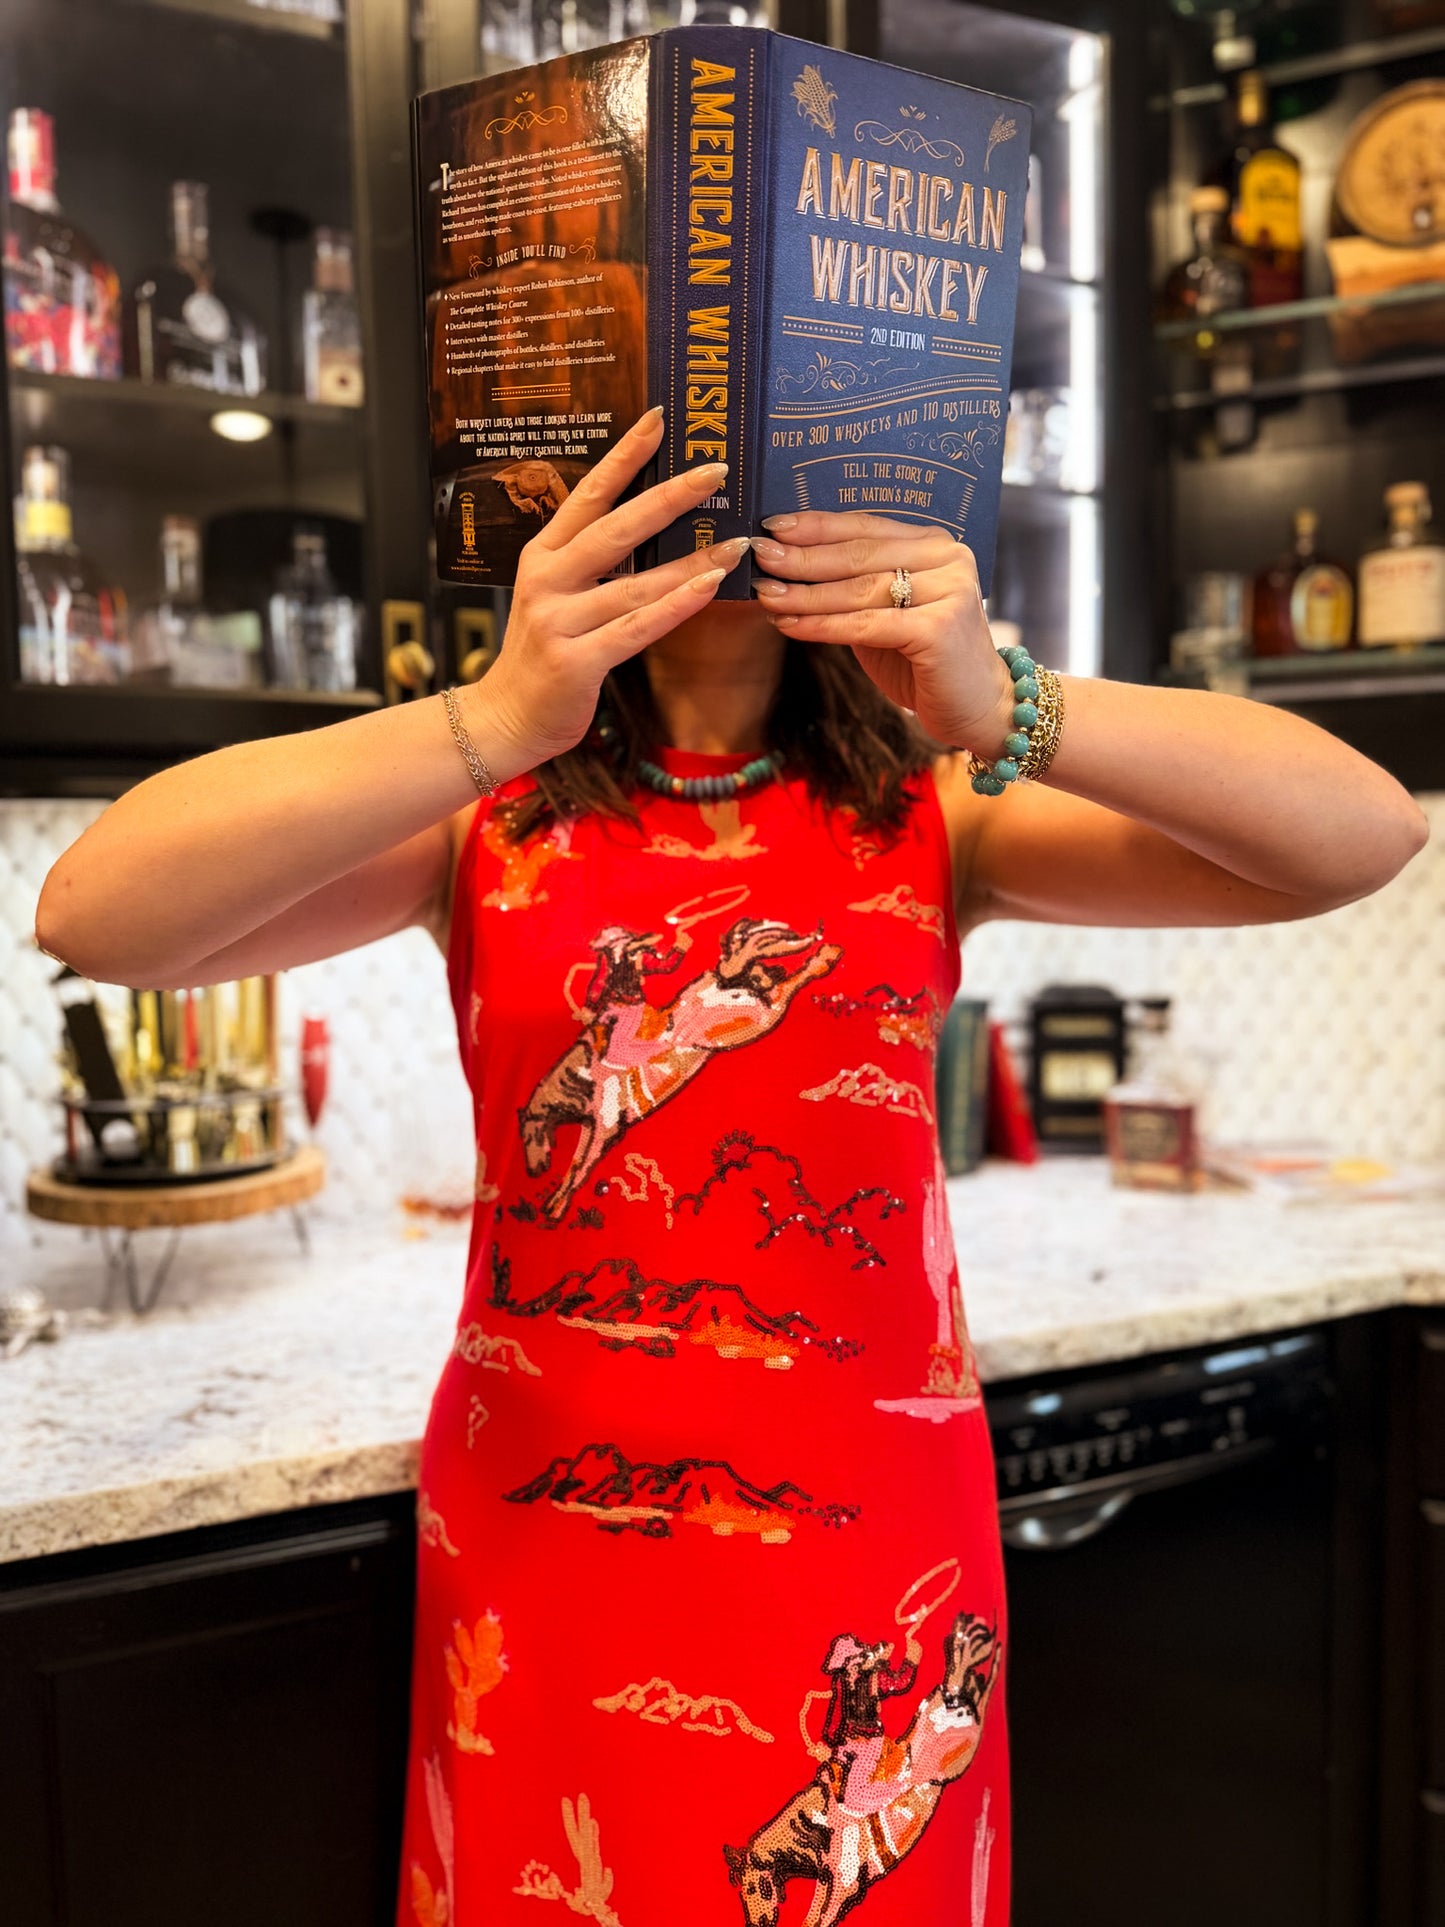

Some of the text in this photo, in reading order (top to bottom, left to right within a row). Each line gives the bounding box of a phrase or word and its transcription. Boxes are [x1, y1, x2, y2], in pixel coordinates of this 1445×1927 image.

[485, 160, 508, 169] American
[509, 154, 528, 164] whiskey
[572, 140, 586, 151] filled
[450, 179, 461, 190] myth
[498, 169, 518, 182] updated
[518, 167, 536, 176] edition
[543, 163, 553, 171] this
[554, 159, 567, 169] book
[578, 153, 605, 164] testament
[612, 149, 622, 157] the
[688, 58, 736, 285] AMERICAN
[442, 196, 453, 205] truth
[454, 194, 467, 202] about
[486, 185, 505, 196] national
[506, 184, 518, 194] spirit
[536, 177, 550, 186] today.
[551, 173, 567, 182] Noted
[568, 170, 588, 179] whiskey
[442, 207, 459, 217] Richard
[486, 198, 509, 210] compiled
[515, 195, 537, 204] extensive
[538, 189, 569, 200] examination
[596, 179, 622, 188] whiskeys,
[794, 147, 1007, 253] AMERICAN
[442, 221, 464, 230] bourbons,
[485, 215, 498, 224] being
[499, 212, 512, 220] made
[512, 206, 549, 218] coast-to-coast,
[549, 202, 572, 212] featuring
[573, 198, 594, 207] stalwart
[594, 194, 622, 206] producers
[464, 229, 490, 240] unorthodox
[492, 227, 512, 237] upstarts.
[496, 244, 566, 267] INSIDE YOU'LL FIND
[461, 288, 485, 299] Foreword
[492, 286, 512, 295] whiskey
[513, 284, 530, 294] expert
[531, 281, 548, 290] Robin
[548, 278, 576, 288] Robinson,
[577, 275, 596, 284] author
[810, 235, 988, 325] WHISKEY
[450, 321, 471, 330] Detailed
[525, 313, 556, 324] expressions
[556, 310, 570, 319] from
[585, 306, 616, 316] distilleries
[460, 305, 485, 315] Complete
[486, 302, 508, 311] Whiskey
[509, 300, 528, 309] Course
[476, 334, 488, 342] with
[506, 330, 529, 340] distillers
[871, 328, 925, 350] 2ND EDITION
[451, 350, 475, 360] Hundreds
[482, 347, 513, 359] photographs
[520, 345, 539, 354] bottles,
[540, 343, 565, 352] distillers,
[565, 341, 576, 350] and
[576, 339, 606, 348] distilleries
[451, 366, 473, 376] Regional
[473, 365, 494, 374] chapters
[505, 362, 519, 370] make
[543, 358, 555, 367] find
[555, 357, 584, 366] distilleries
[584, 353, 616, 363] nationwide
[684, 304, 731, 489] WHISKE
[470, 419, 492, 431] WHISKEY
[493, 418, 514, 429] LOVERS
[514, 417, 526, 426] AND
[526, 416, 543, 426] THOSE
[544, 415, 568, 425] LOOKING
[568, 415, 576, 424] TO
[576, 414, 595, 424] LEARN
[596, 412, 612, 422] MORE
[771, 400, 1001, 448] OVER 300 WHISKEYS AND 110 DISTILLERS
[460, 429, 608, 443] ABOUT THE NATION'S SPIRIT WILL FIND THIS NEW EDITION
[476, 448, 483, 457] OF
[534, 446, 562, 458] ESSENTIAL
[564, 445, 589, 455] READING.
[843, 462, 938, 484] TELL THE STORY OF
[838, 486, 933, 507] THE NATION'S SPIRIT
